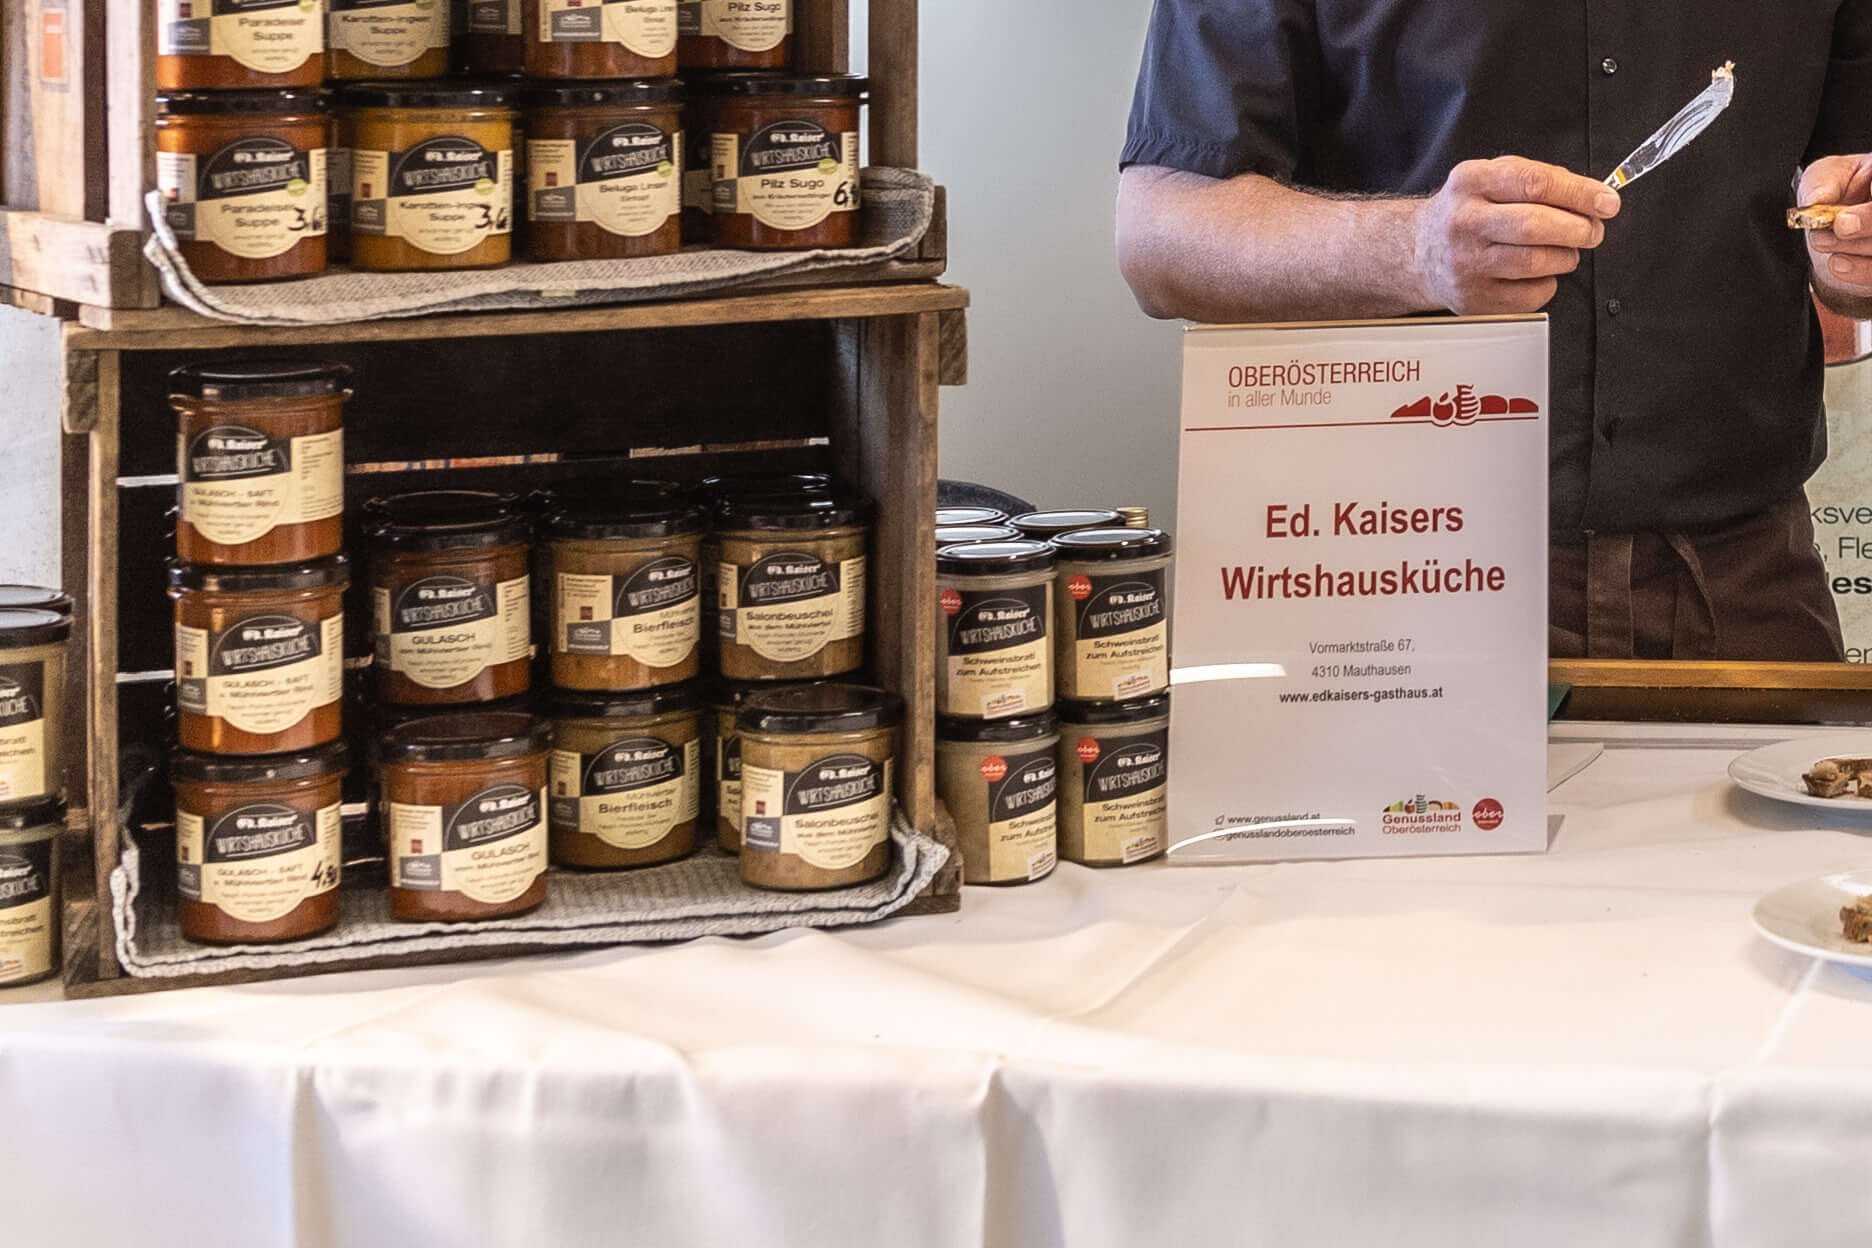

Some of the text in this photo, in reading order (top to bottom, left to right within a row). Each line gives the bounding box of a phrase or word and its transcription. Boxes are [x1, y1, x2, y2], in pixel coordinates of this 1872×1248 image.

[728, 2, 782, 13] Pilz Sugo
[599, 183, 637, 195] Beluga
[761, 178, 825, 191] Pilz Sugo
[235, 215, 280, 229] Suppe
[429, 212, 467, 224] Suppe
[1228, 359, 1422, 388] OBERÖSTERREICH
[1228, 388, 1332, 408] in aller Munde
[1266, 501, 1464, 539] Ed. Kaisers
[1221, 559, 1505, 601] Wirtshausküche
[1826, 571, 1872, 595] es
[412, 632, 476, 646] GULASCH
[1309, 639, 1395, 656] Vormarktstraße
[1312, 663, 1412, 679] 4310 Mauthausen
[1280, 686, 1443, 704] www.edkaisers-gasthaus.at
[598, 797, 673, 814] Bierfleisch
[1382, 812, 1462, 826] Genussland
[1382, 823, 1462, 836] Oberösterreich
[471, 842, 531, 861] GULASCH
